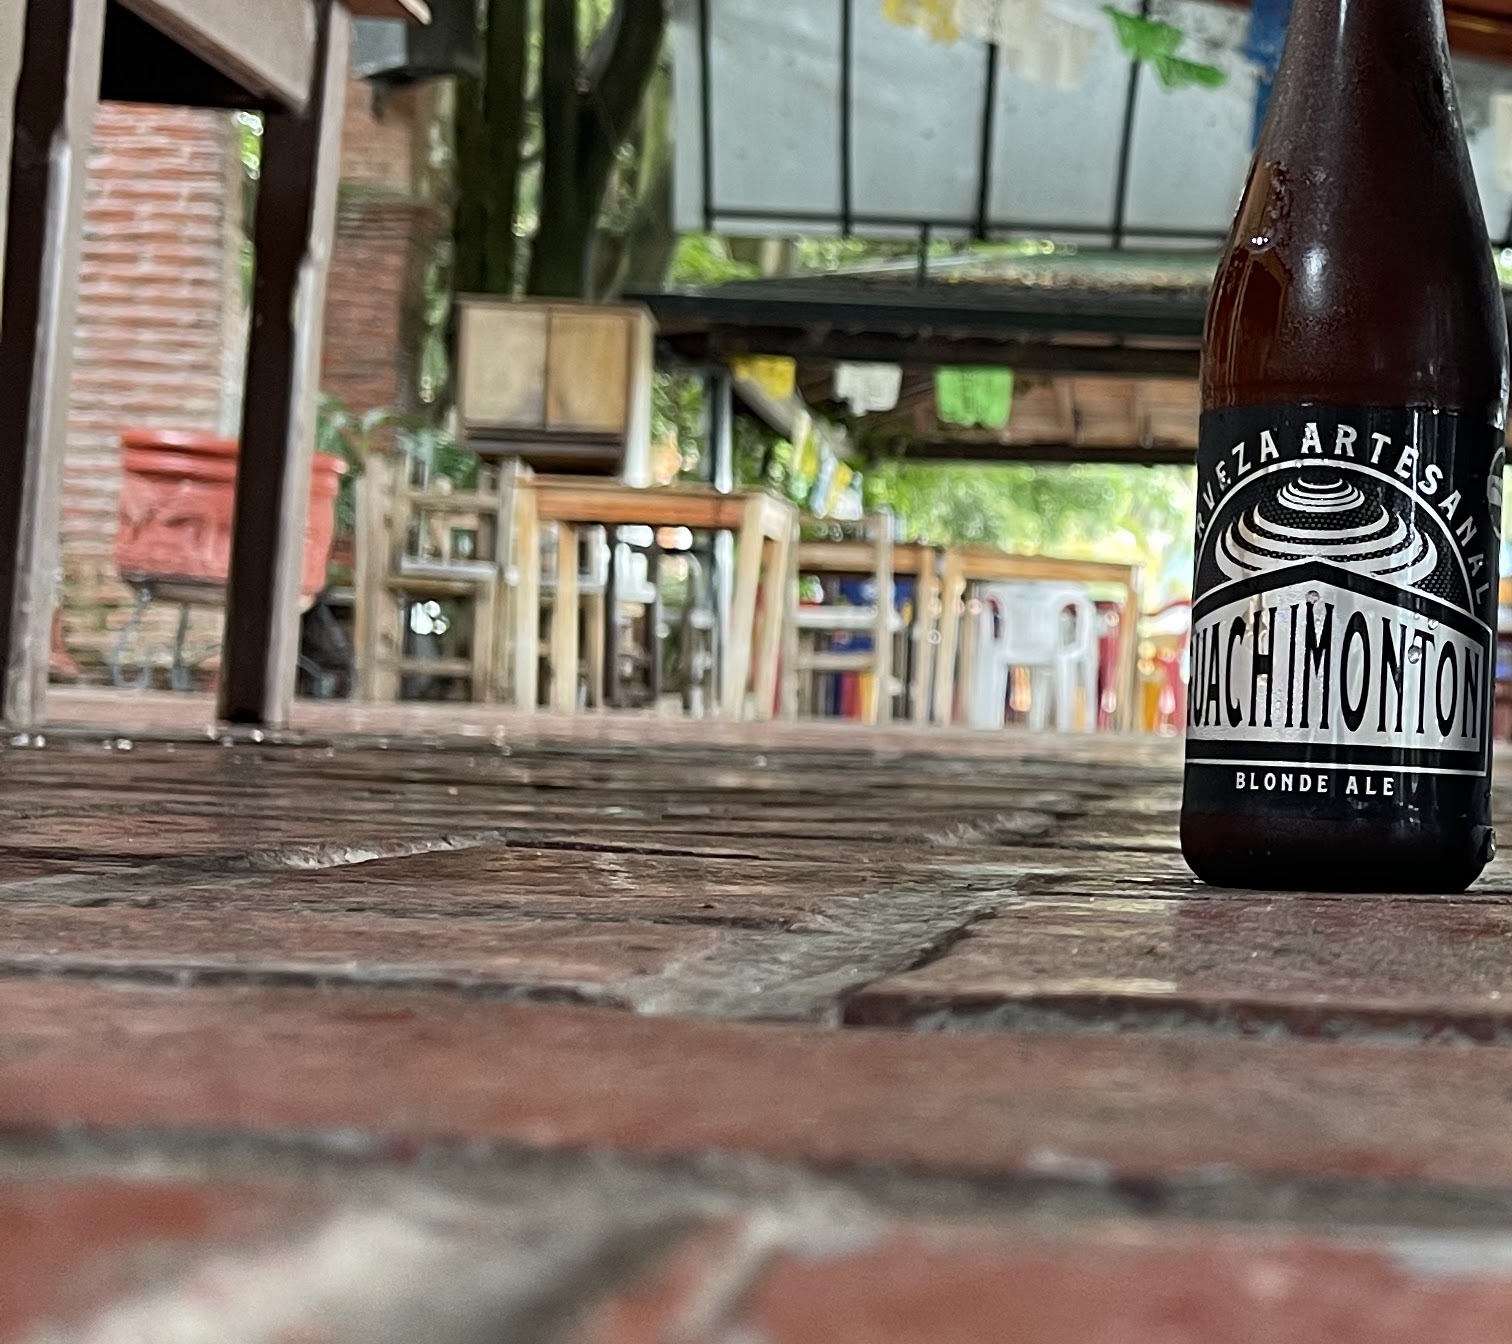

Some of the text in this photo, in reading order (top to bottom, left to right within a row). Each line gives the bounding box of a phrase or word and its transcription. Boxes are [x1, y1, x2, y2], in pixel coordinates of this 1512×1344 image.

[1300, 421, 1491, 606] ARTESANAL
[1235, 771, 1395, 796] BLONDE ALE
